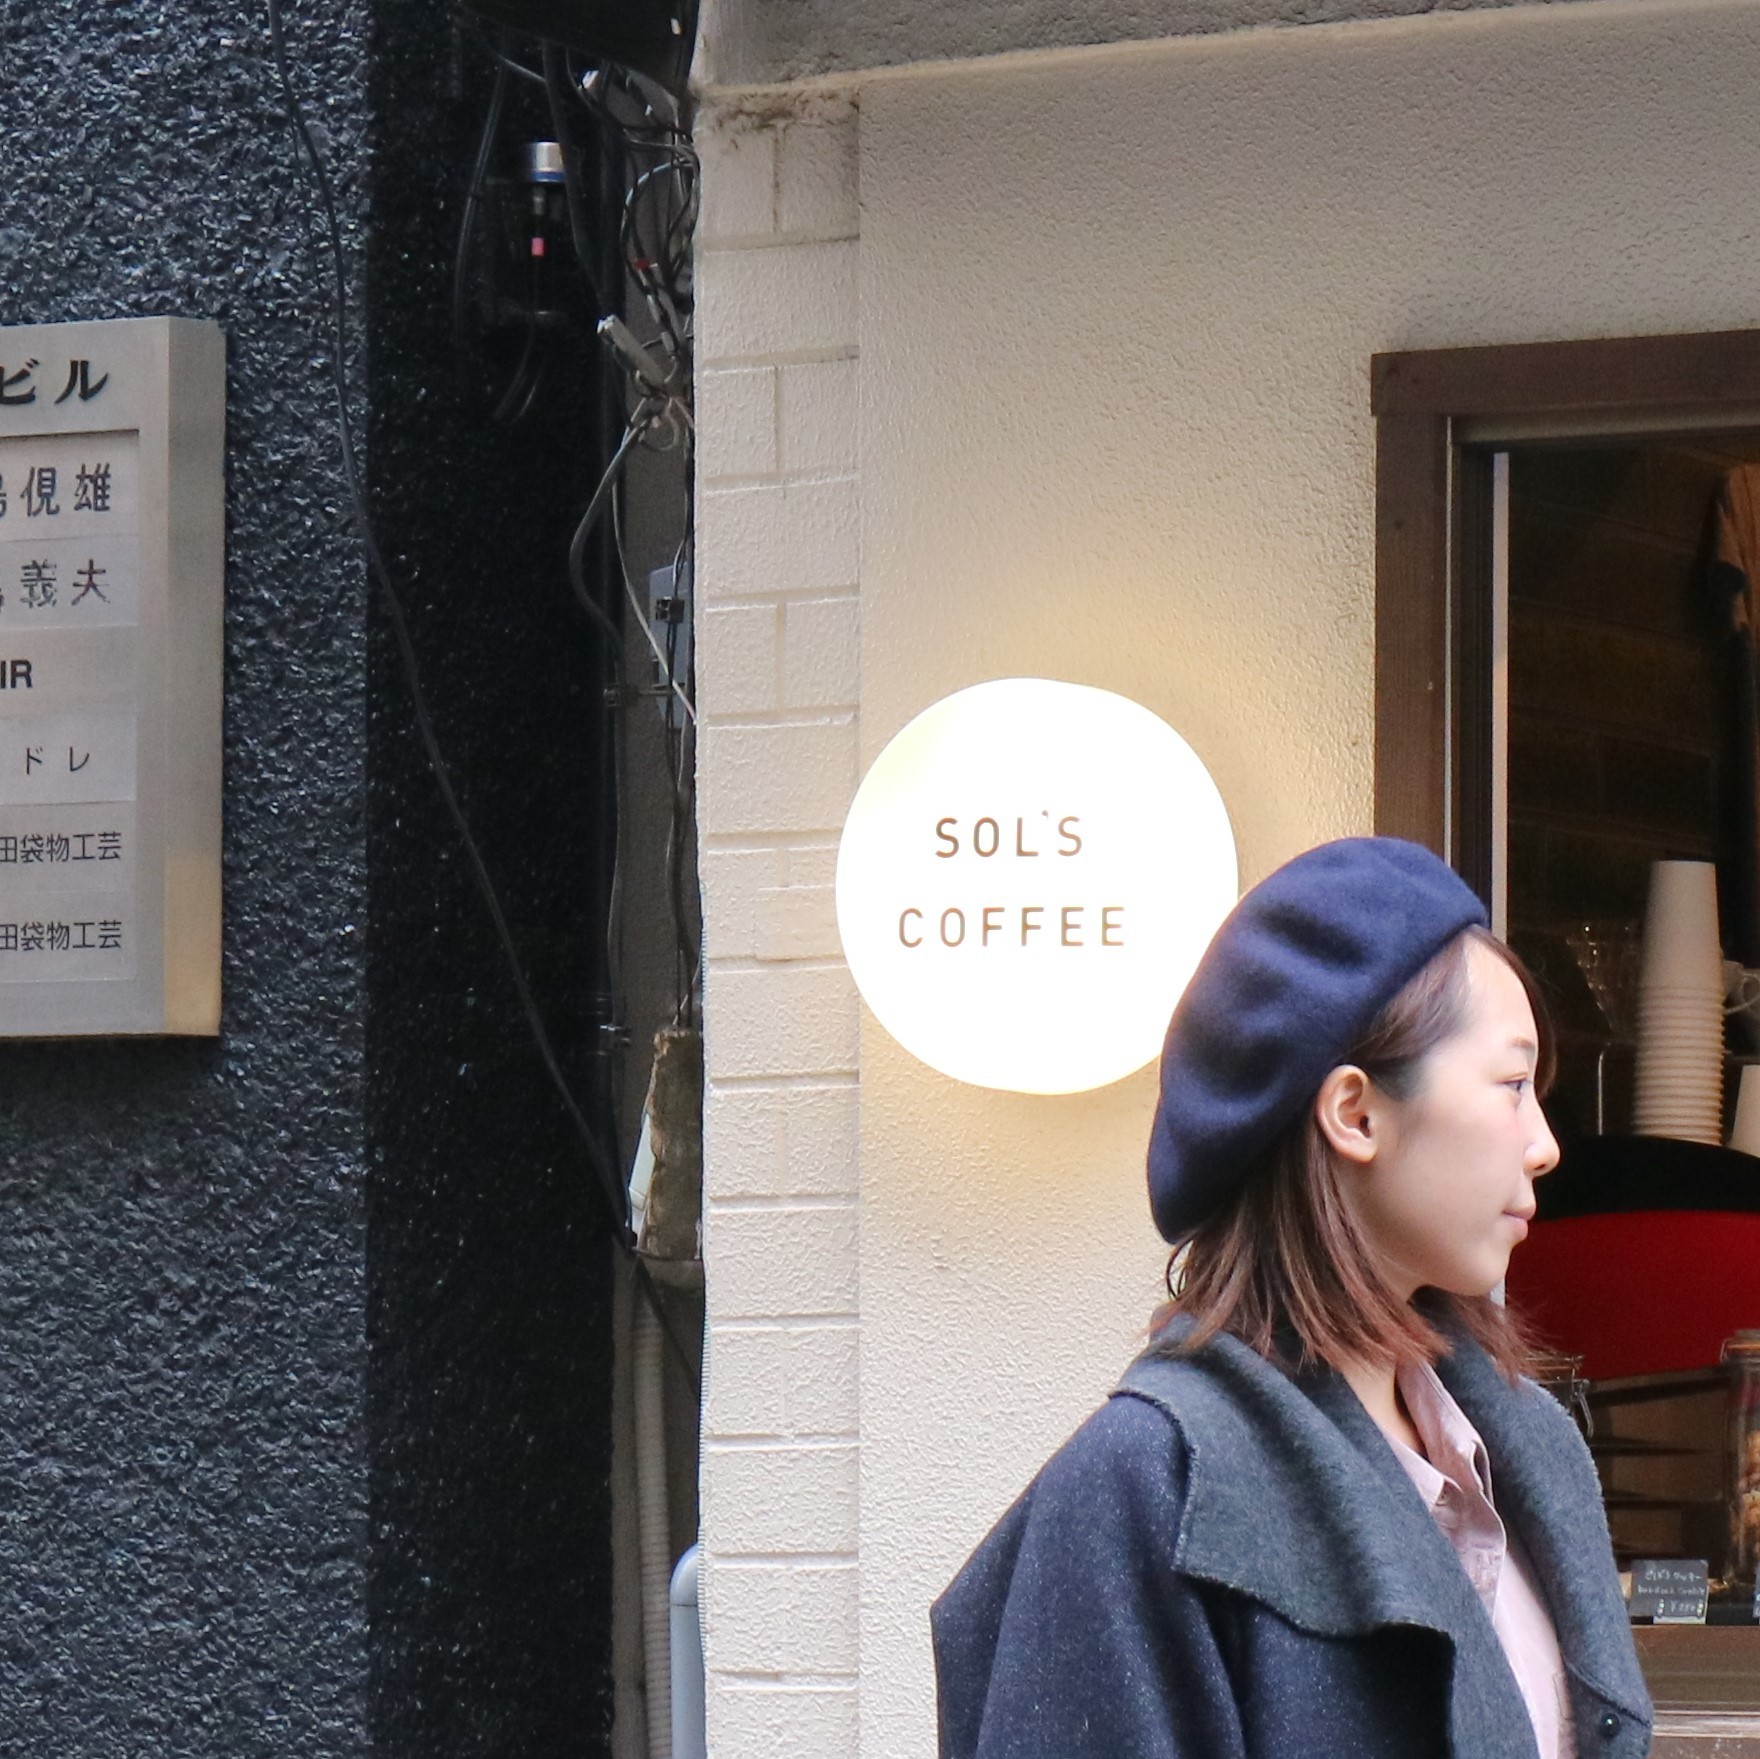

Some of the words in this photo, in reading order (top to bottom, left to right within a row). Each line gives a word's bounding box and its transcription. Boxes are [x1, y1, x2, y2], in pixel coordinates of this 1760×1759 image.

[0, 358, 109, 405] ビル
[934, 809, 1084, 858] SOL'S
[898, 906, 1126, 948] COFFEE
